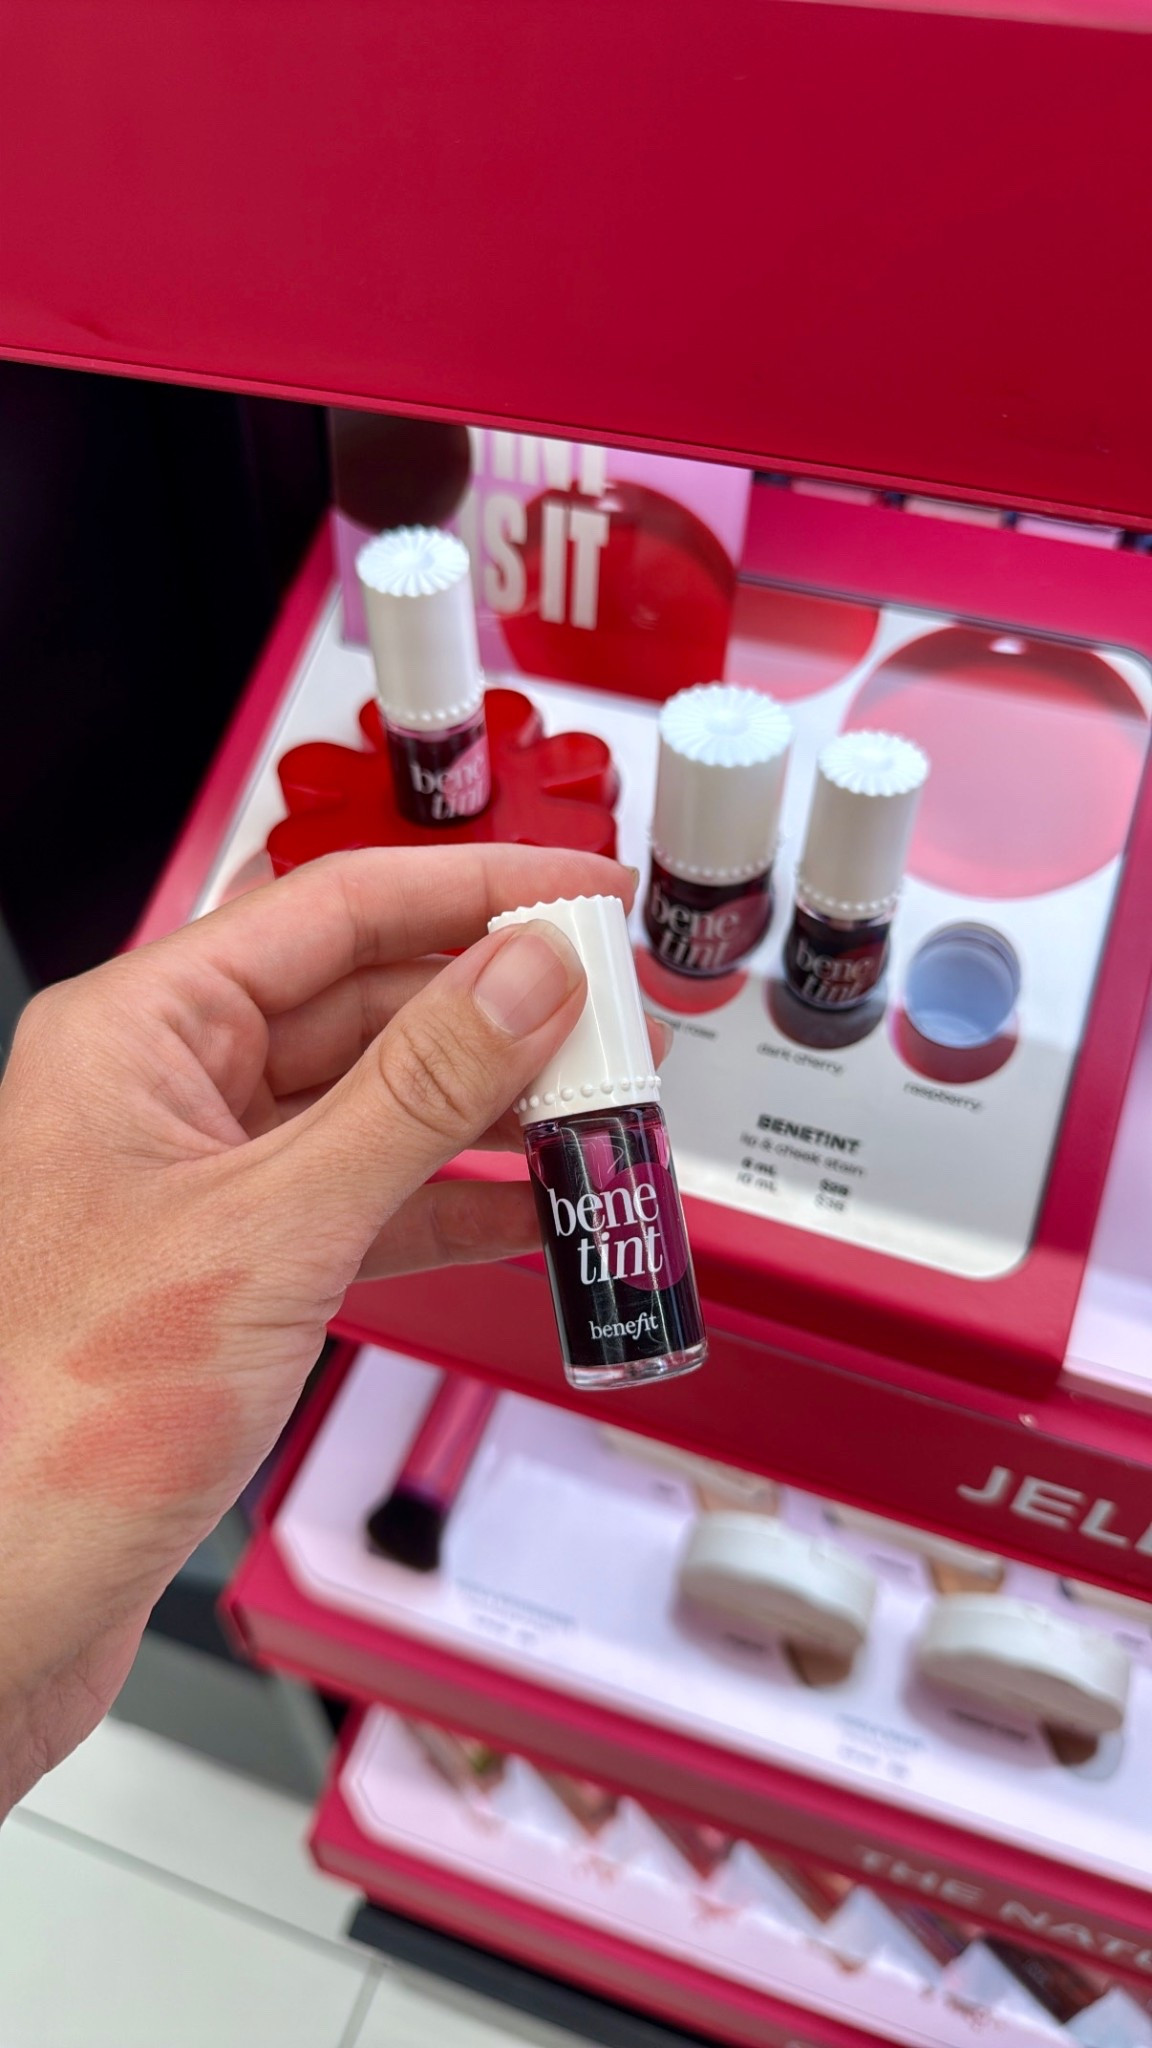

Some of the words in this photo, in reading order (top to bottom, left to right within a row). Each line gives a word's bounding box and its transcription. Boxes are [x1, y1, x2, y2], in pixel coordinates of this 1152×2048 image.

[539, 500, 610, 631] IT
[410, 754, 485, 795] bene
[651, 883, 740, 940] bene
[659, 930, 730, 968] tint
[796, 938, 873, 981] bene
[757, 1113, 862, 1156] BENETINT
[547, 1182, 659, 1237] bene
[577, 1226, 663, 1285] tint
[589, 1312, 659, 1340] benefit
